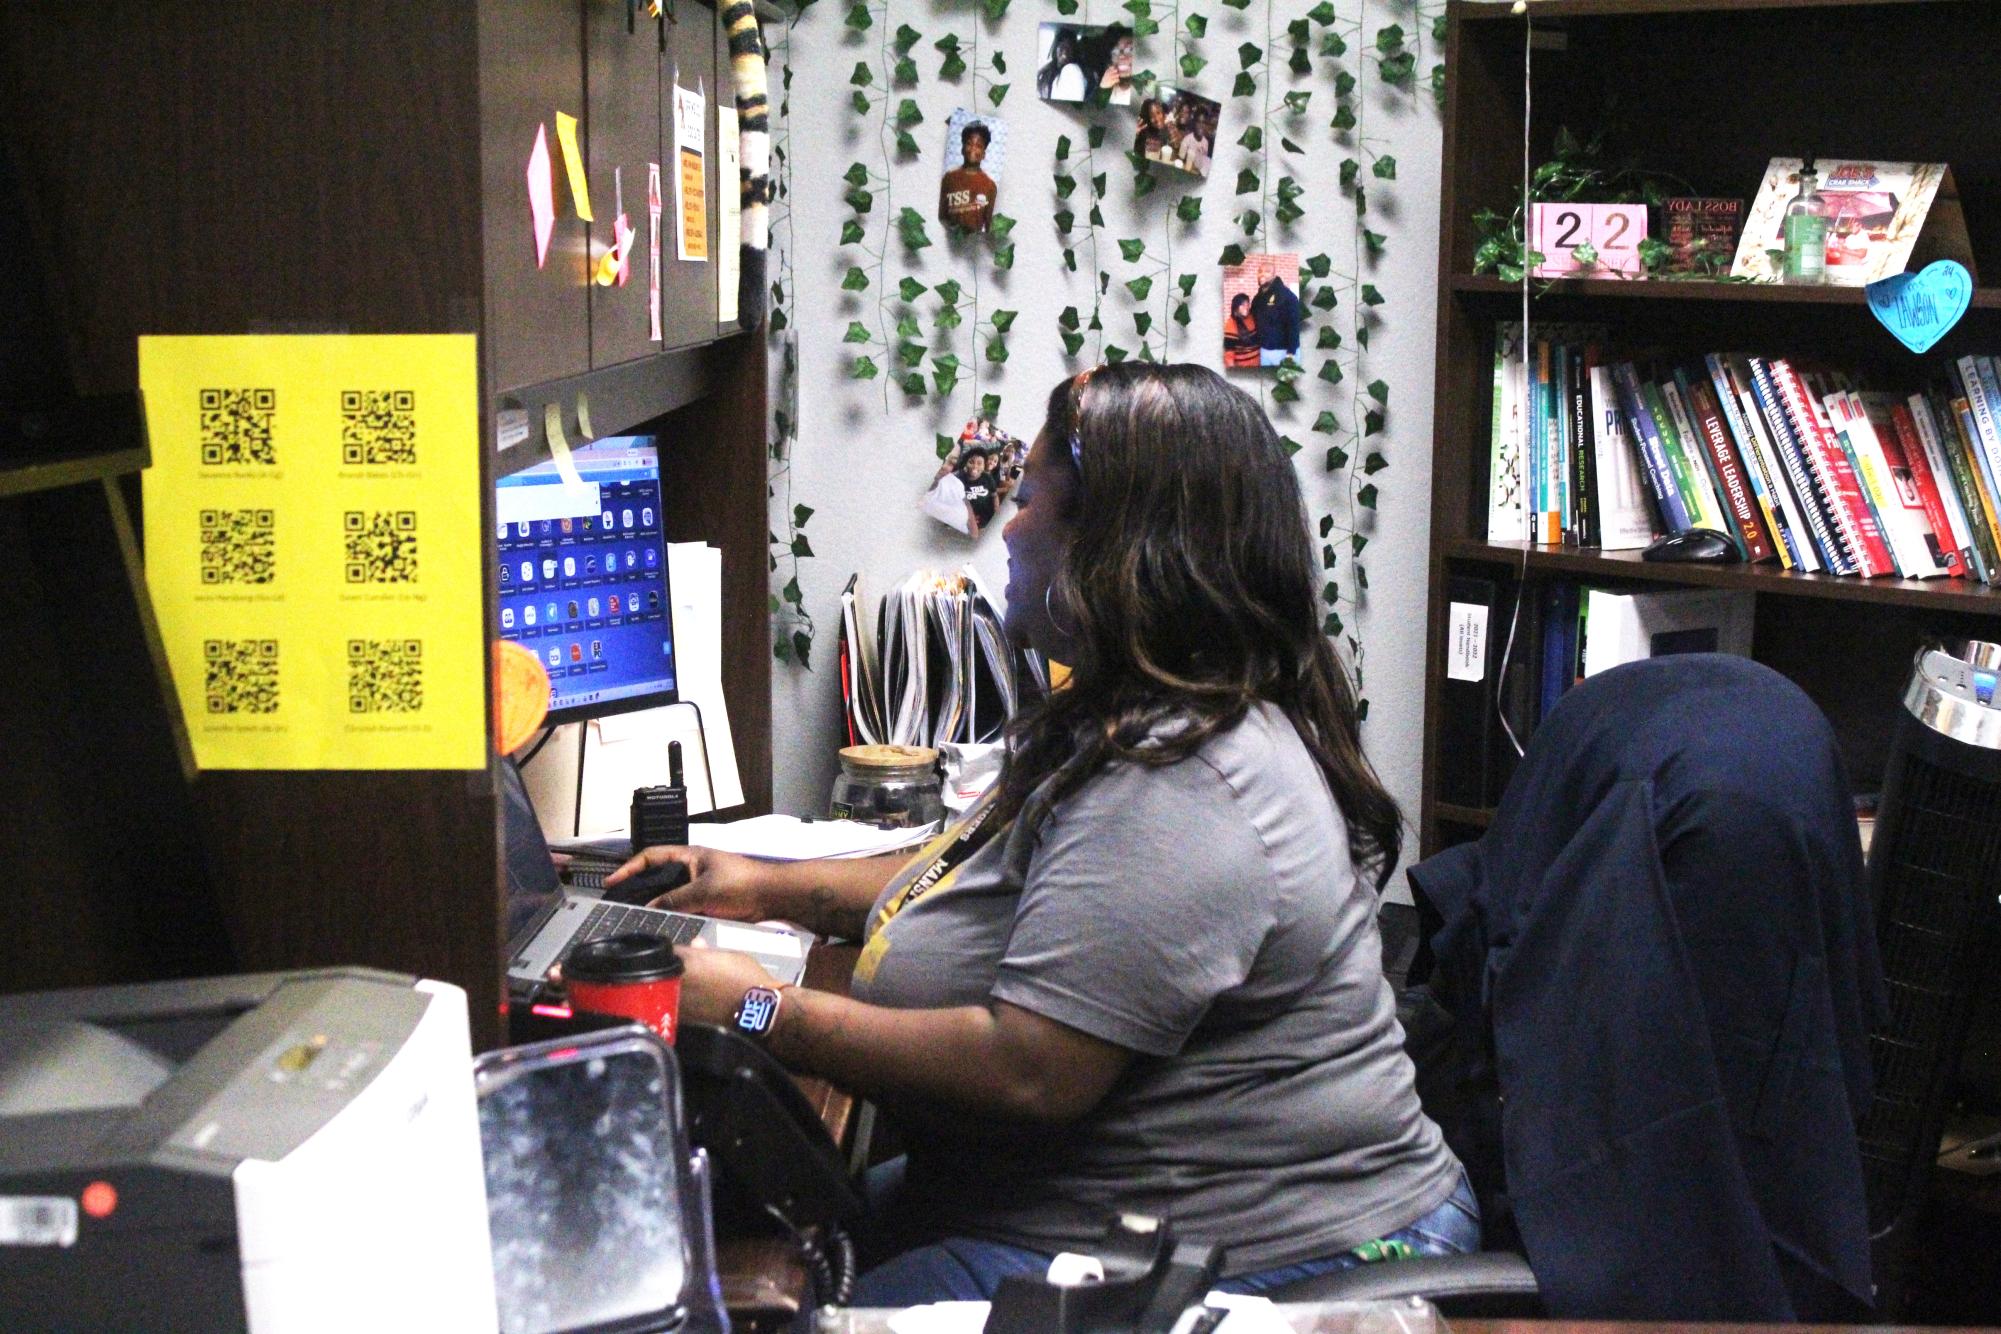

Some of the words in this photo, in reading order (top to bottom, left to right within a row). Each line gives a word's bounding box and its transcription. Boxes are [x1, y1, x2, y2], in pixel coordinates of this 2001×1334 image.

[946, 190, 970, 206] TSS
[1555, 211, 1581, 248] 2
[1602, 212, 1630, 250] 2
[1575, 394, 1584, 447] EDUCATIONAL
[1966, 365, 1989, 425] LEARNING
[1985, 428, 1995, 443] BY
[1578, 449, 1586, 490] RESEARCH
[1630, 416, 1655, 469] Student-Focused
[1648, 468, 1665, 499] Coaching
[1648, 435, 1666, 470] Street
[1660, 469, 1676, 496] Data
[1705, 417, 1730, 464] LEVERAGE
[1722, 464, 1751, 520] LEADERSHIP
[1743, 521, 1758, 539] 2.0
[1740, 412, 1754, 437] Making
[1749, 435, 1772, 484] Differentiation
[1769, 488, 1781, 506] Habit
